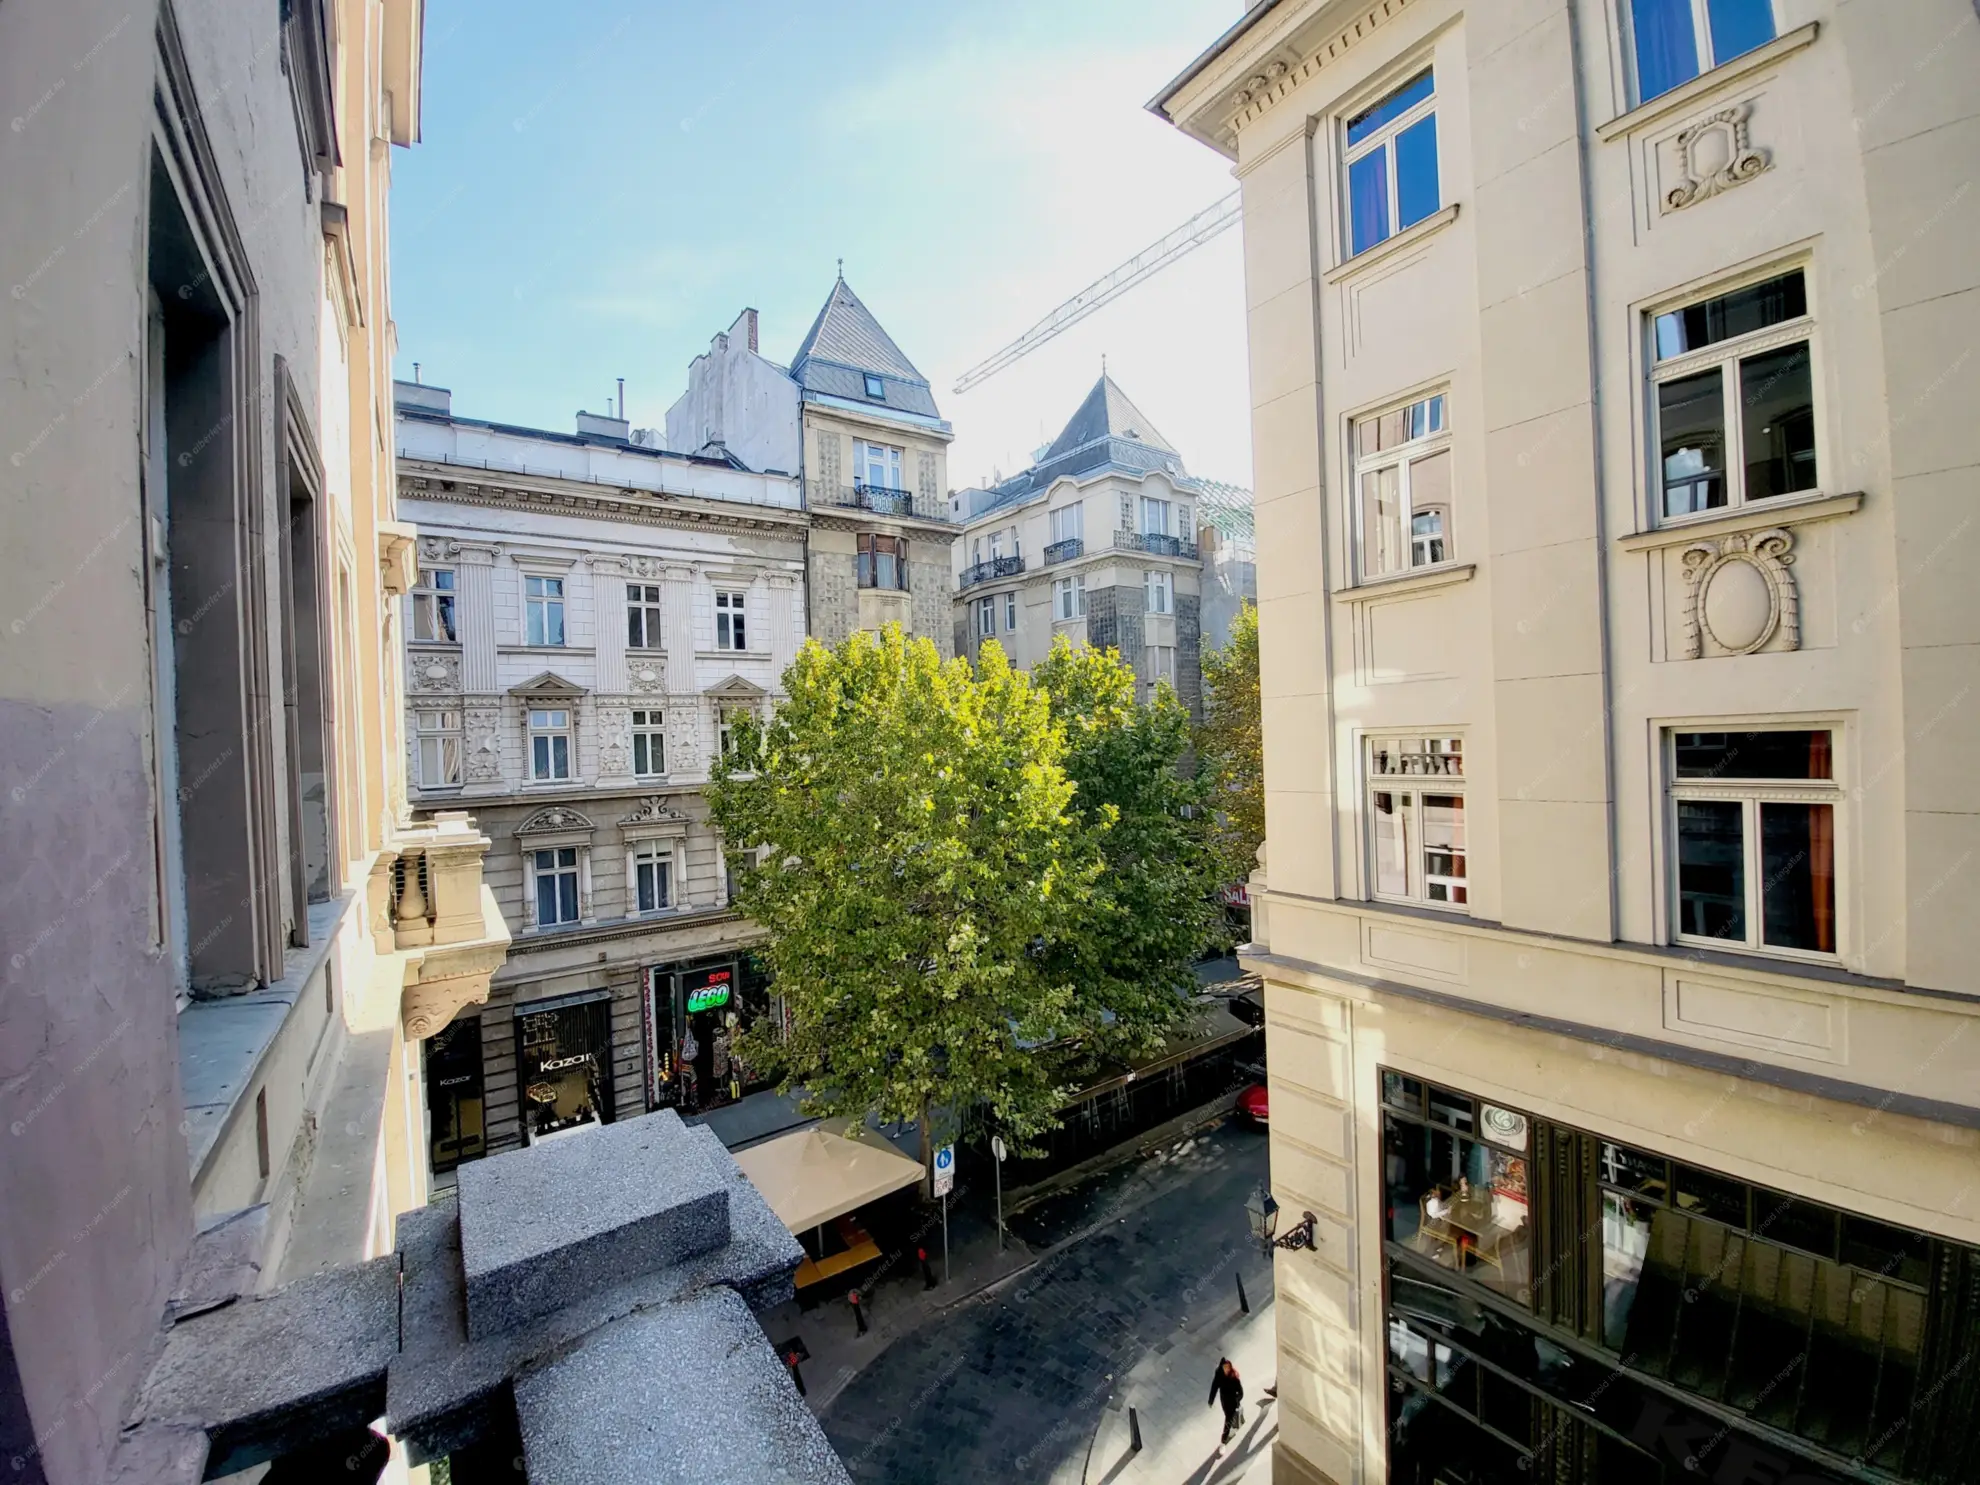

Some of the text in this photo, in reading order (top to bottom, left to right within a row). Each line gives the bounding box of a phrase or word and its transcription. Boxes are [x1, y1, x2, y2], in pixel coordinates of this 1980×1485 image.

[688, 983, 730, 1012] LEGO
[540, 1052, 592, 1072] Kazar
[440, 1075, 472, 1087] Kazar
